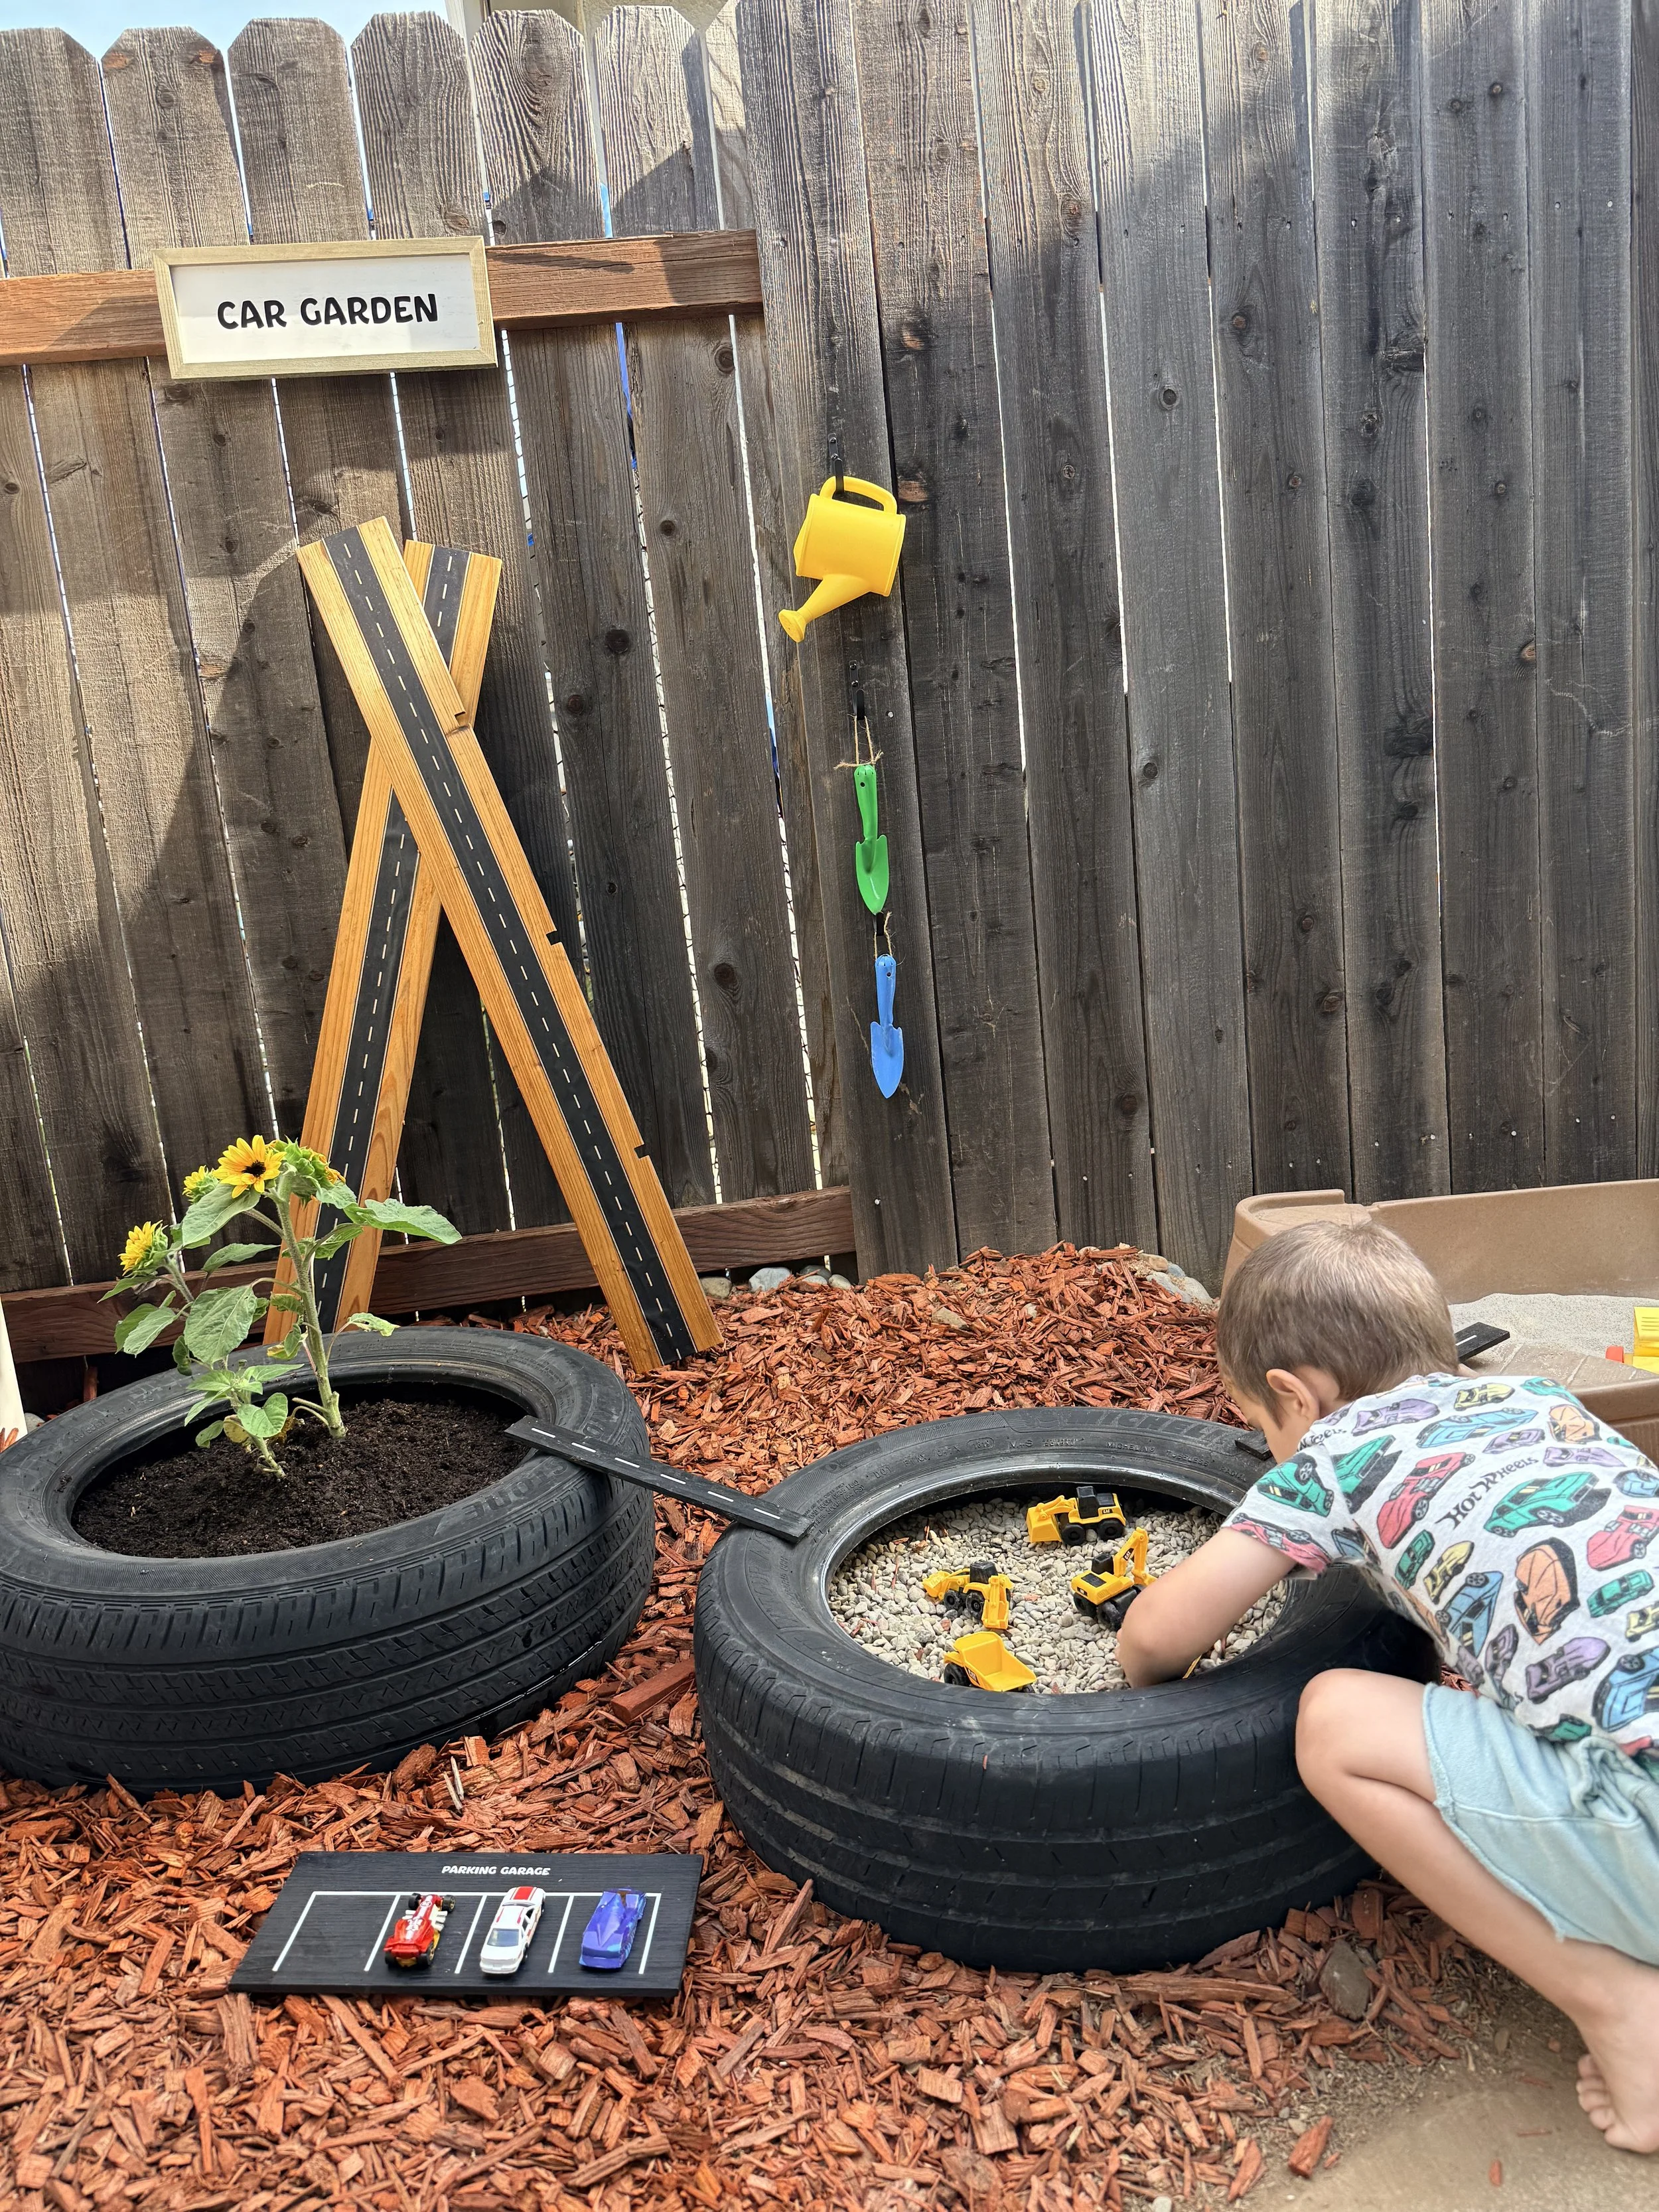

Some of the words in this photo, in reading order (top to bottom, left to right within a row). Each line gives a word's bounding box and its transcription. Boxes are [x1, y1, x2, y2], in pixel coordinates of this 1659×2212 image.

[218, 300, 287, 329] CAR
[300, 293, 438, 326] GARDEN
[1435, 1491, 1482, 1530] Hot
[1469, 1457, 1539, 1492] Wheels
[441, 1865, 497, 1875] PARKING
[500, 1866, 551, 1876] GARAGE
